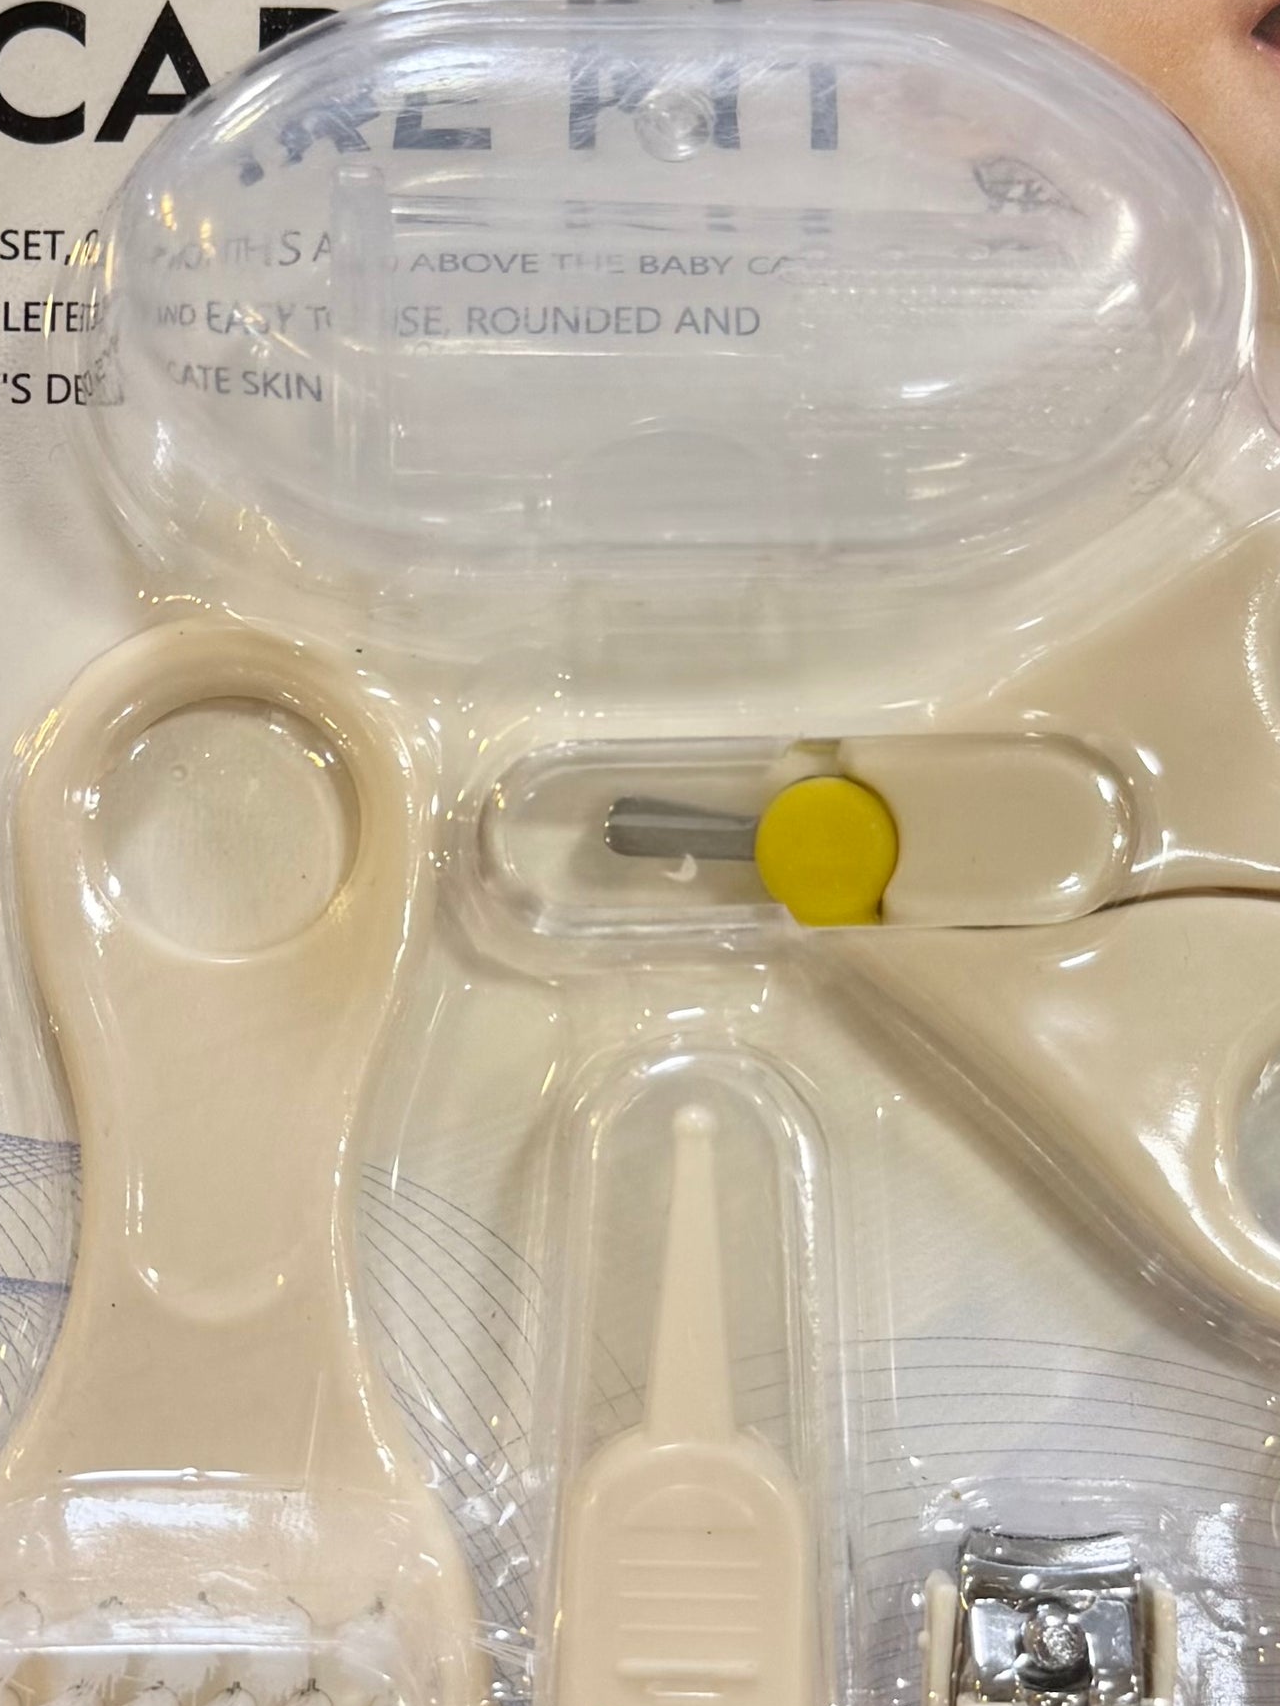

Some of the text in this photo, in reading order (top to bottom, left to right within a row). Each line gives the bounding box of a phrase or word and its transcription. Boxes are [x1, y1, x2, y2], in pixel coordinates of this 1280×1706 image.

[410, 253, 539, 274] ABOVE
[557, 253, 627, 274] THE
[639, 256, 733, 275] BABY
[467, 305, 660, 335] ROUNDED
[674, 306, 760, 336] AND
[242, 371, 323, 404] SKIN
